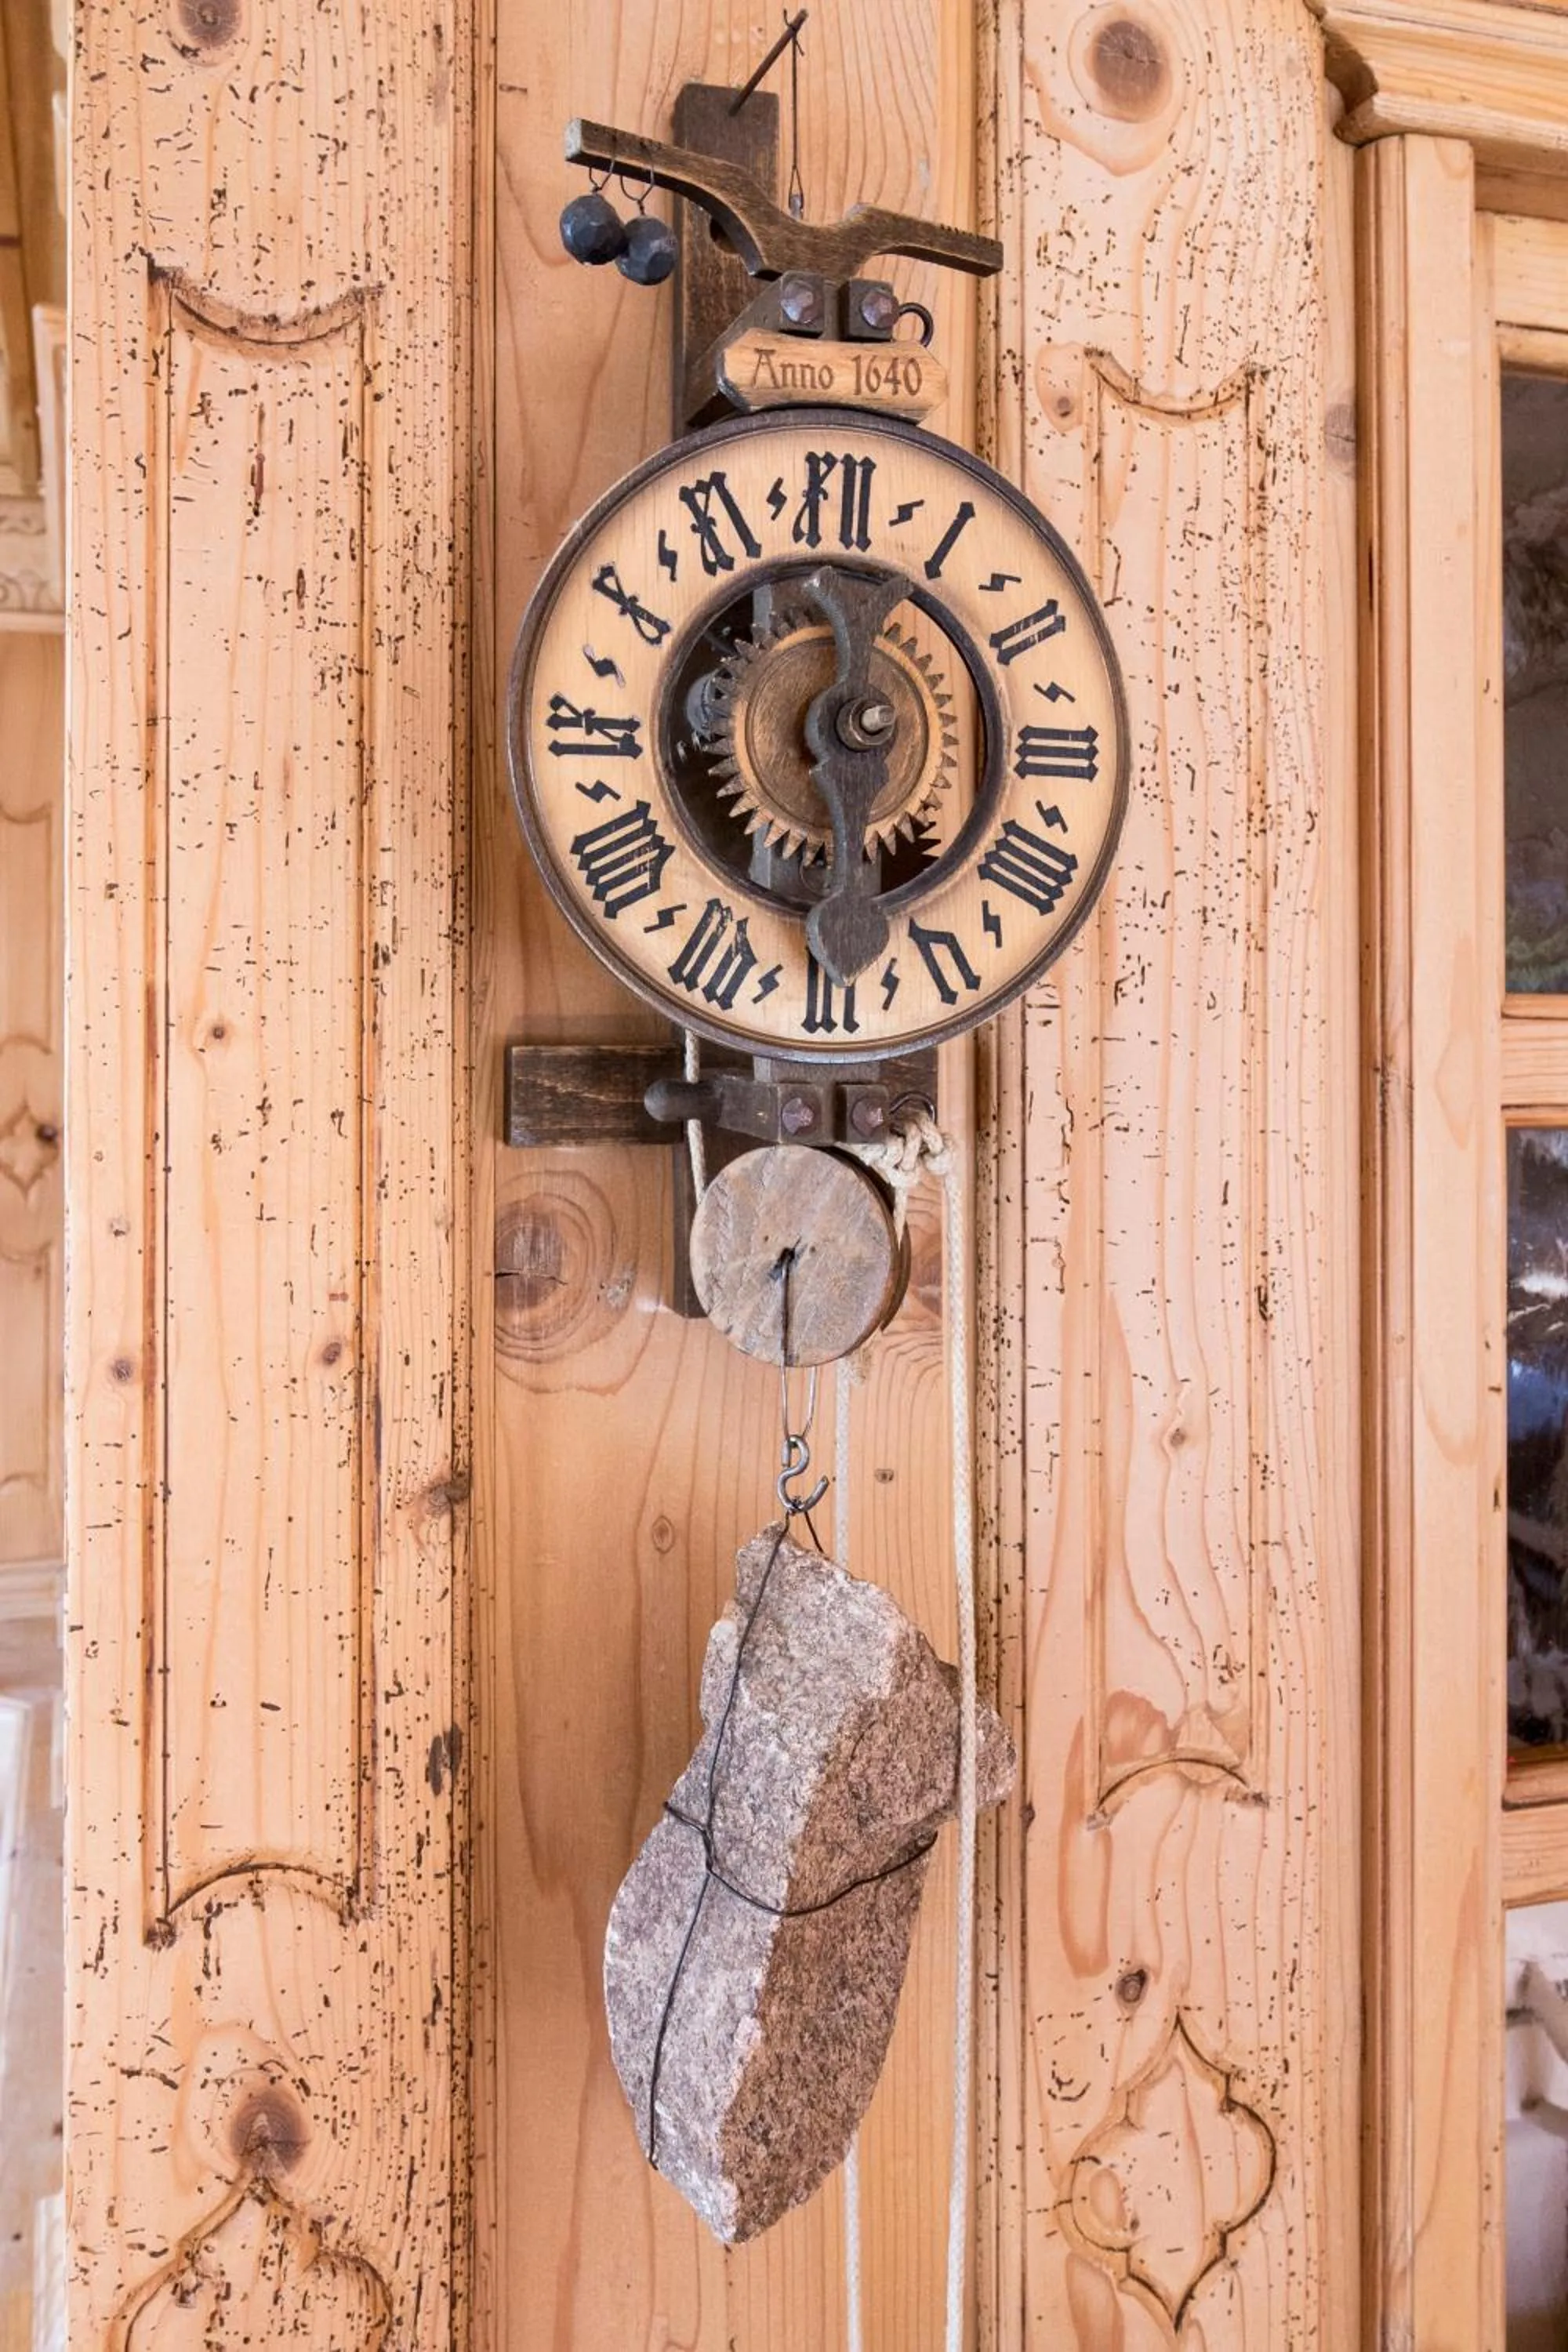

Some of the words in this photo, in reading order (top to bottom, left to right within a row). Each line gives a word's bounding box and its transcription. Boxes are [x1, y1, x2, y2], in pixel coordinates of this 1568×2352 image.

[752, 347, 834, 390] Anno
[850, 354, 923, 396] 1640
[792, 452, 877, 551] XII
[924, 501, 976, 580] I
[989, 597, 1066, 666] II
[1014, 724, 1099, 782] III
